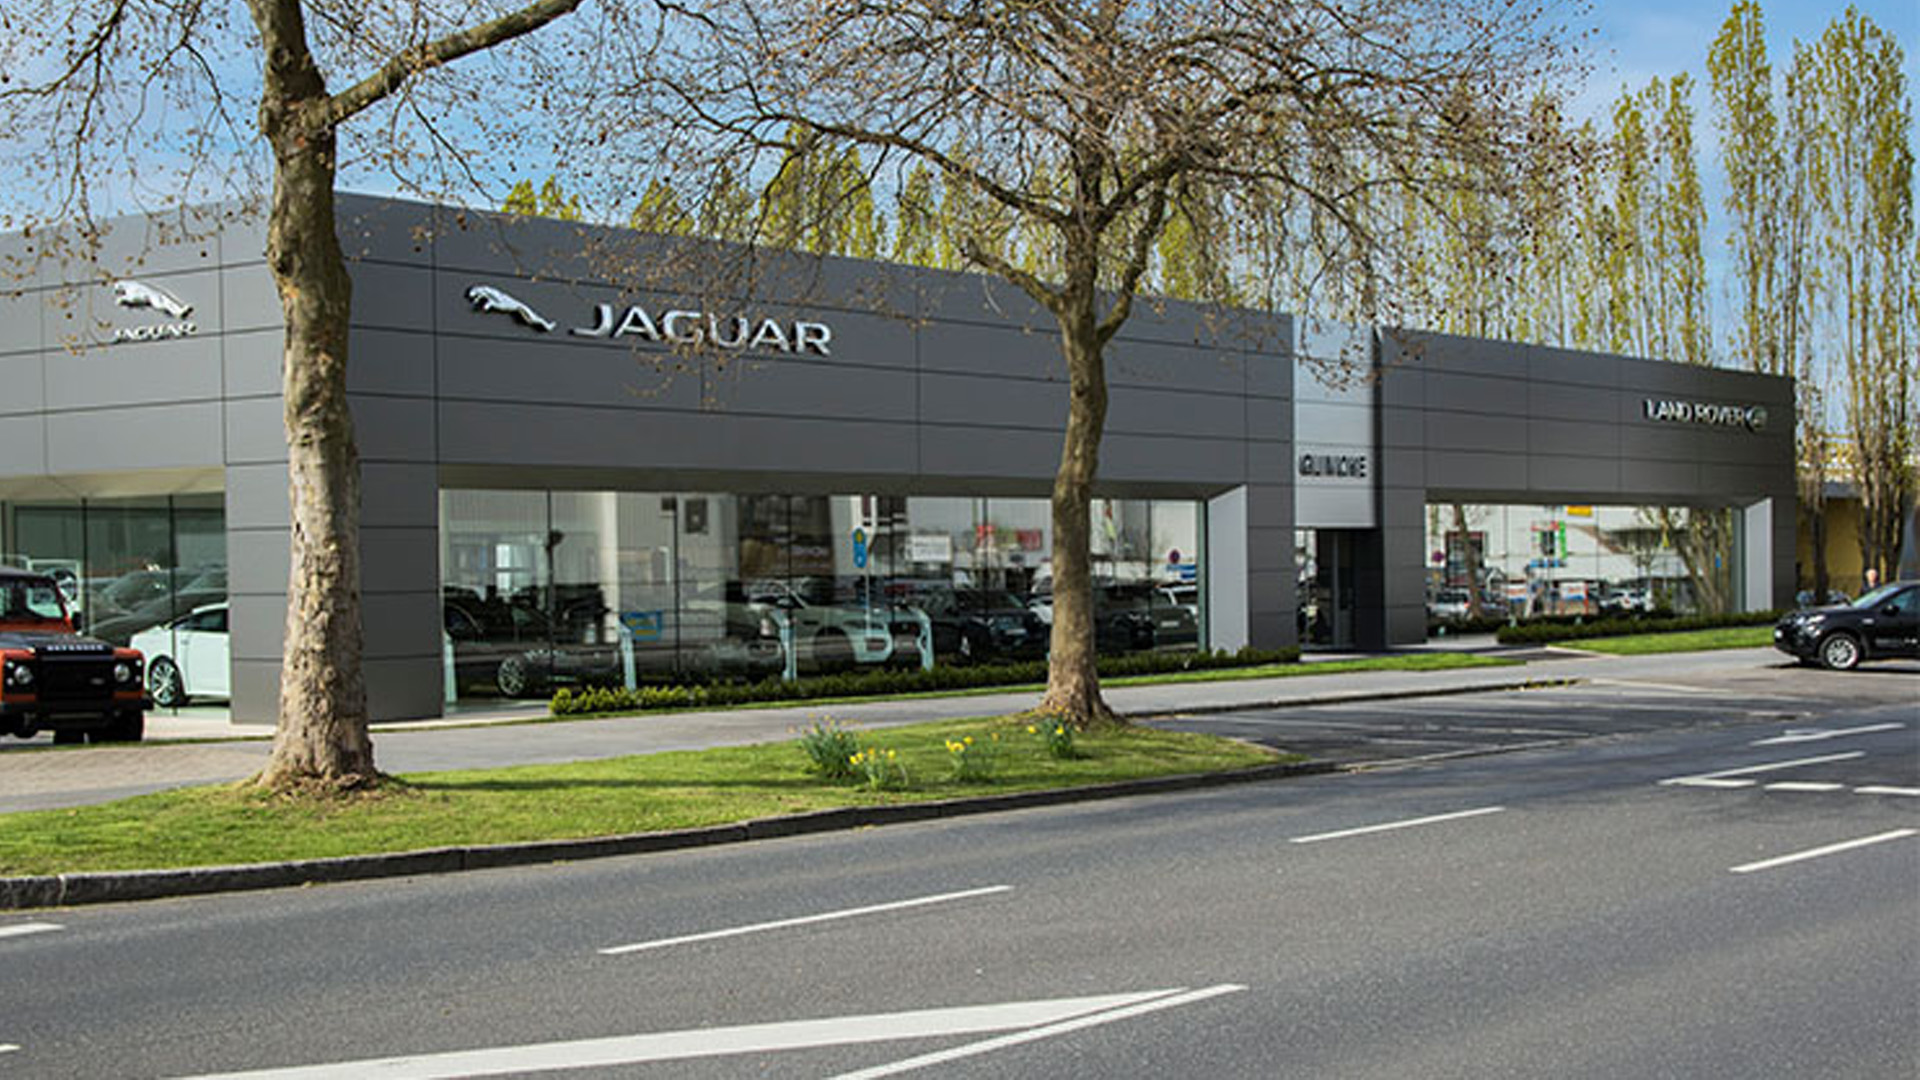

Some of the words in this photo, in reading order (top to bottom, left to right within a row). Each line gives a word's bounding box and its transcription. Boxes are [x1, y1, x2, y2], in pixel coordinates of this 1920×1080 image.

[112, 322, 197, 341] JAGUAR
[571, 303, 832, 356] JAGUAR
[1644, 399, 1692, 423] LAND
[1694, 403, 1745, 426] ROVER
